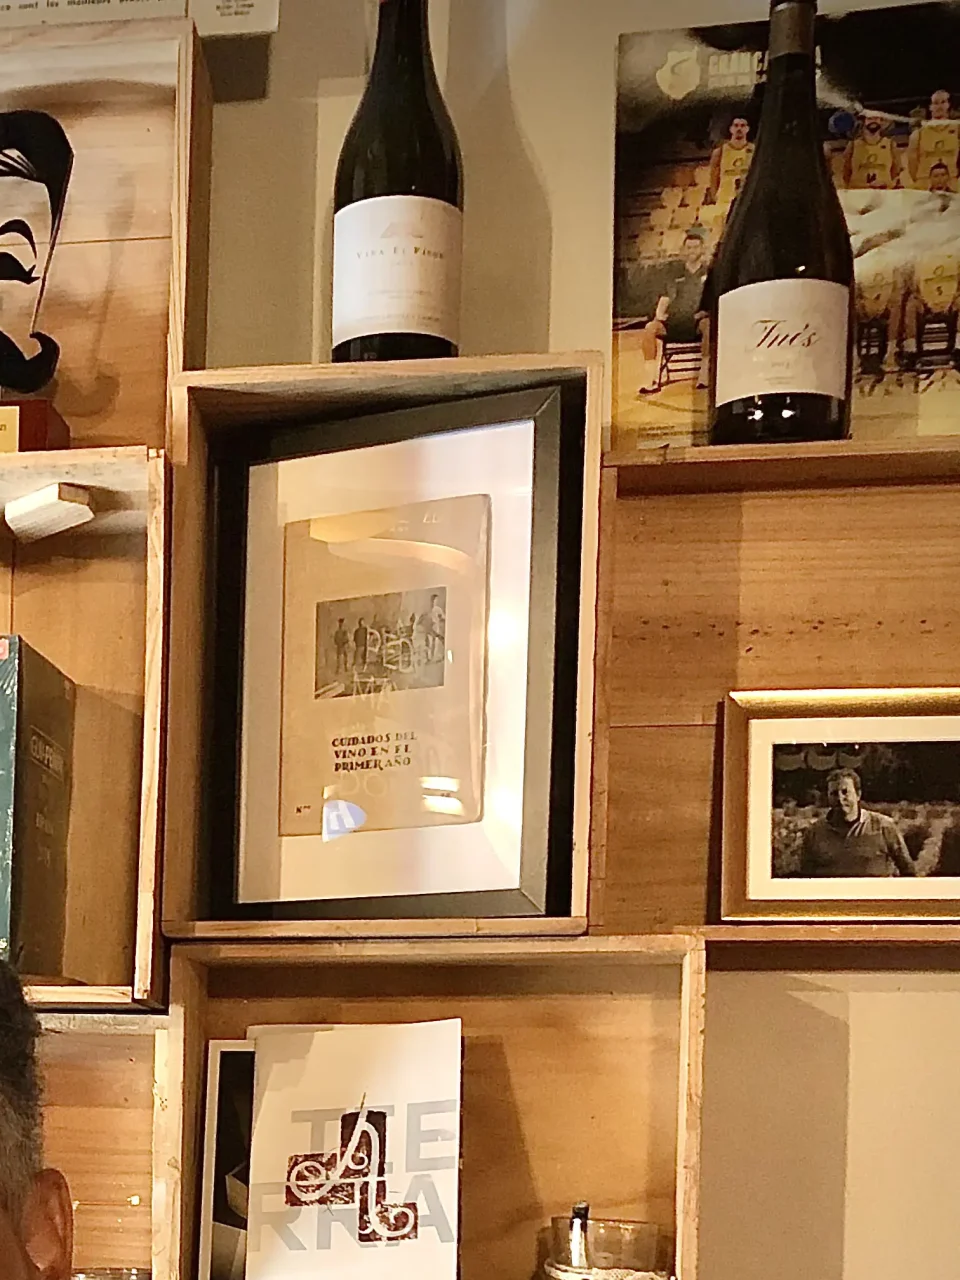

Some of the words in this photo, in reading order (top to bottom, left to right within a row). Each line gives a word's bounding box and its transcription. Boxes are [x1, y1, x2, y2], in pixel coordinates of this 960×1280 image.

[331, 733, 391, 747] CUIDADOS
[334, 747, 367, 759] VINO
[334, 759, 383, 773] PRIMER
[384, 755, 411, 768] AÑO
